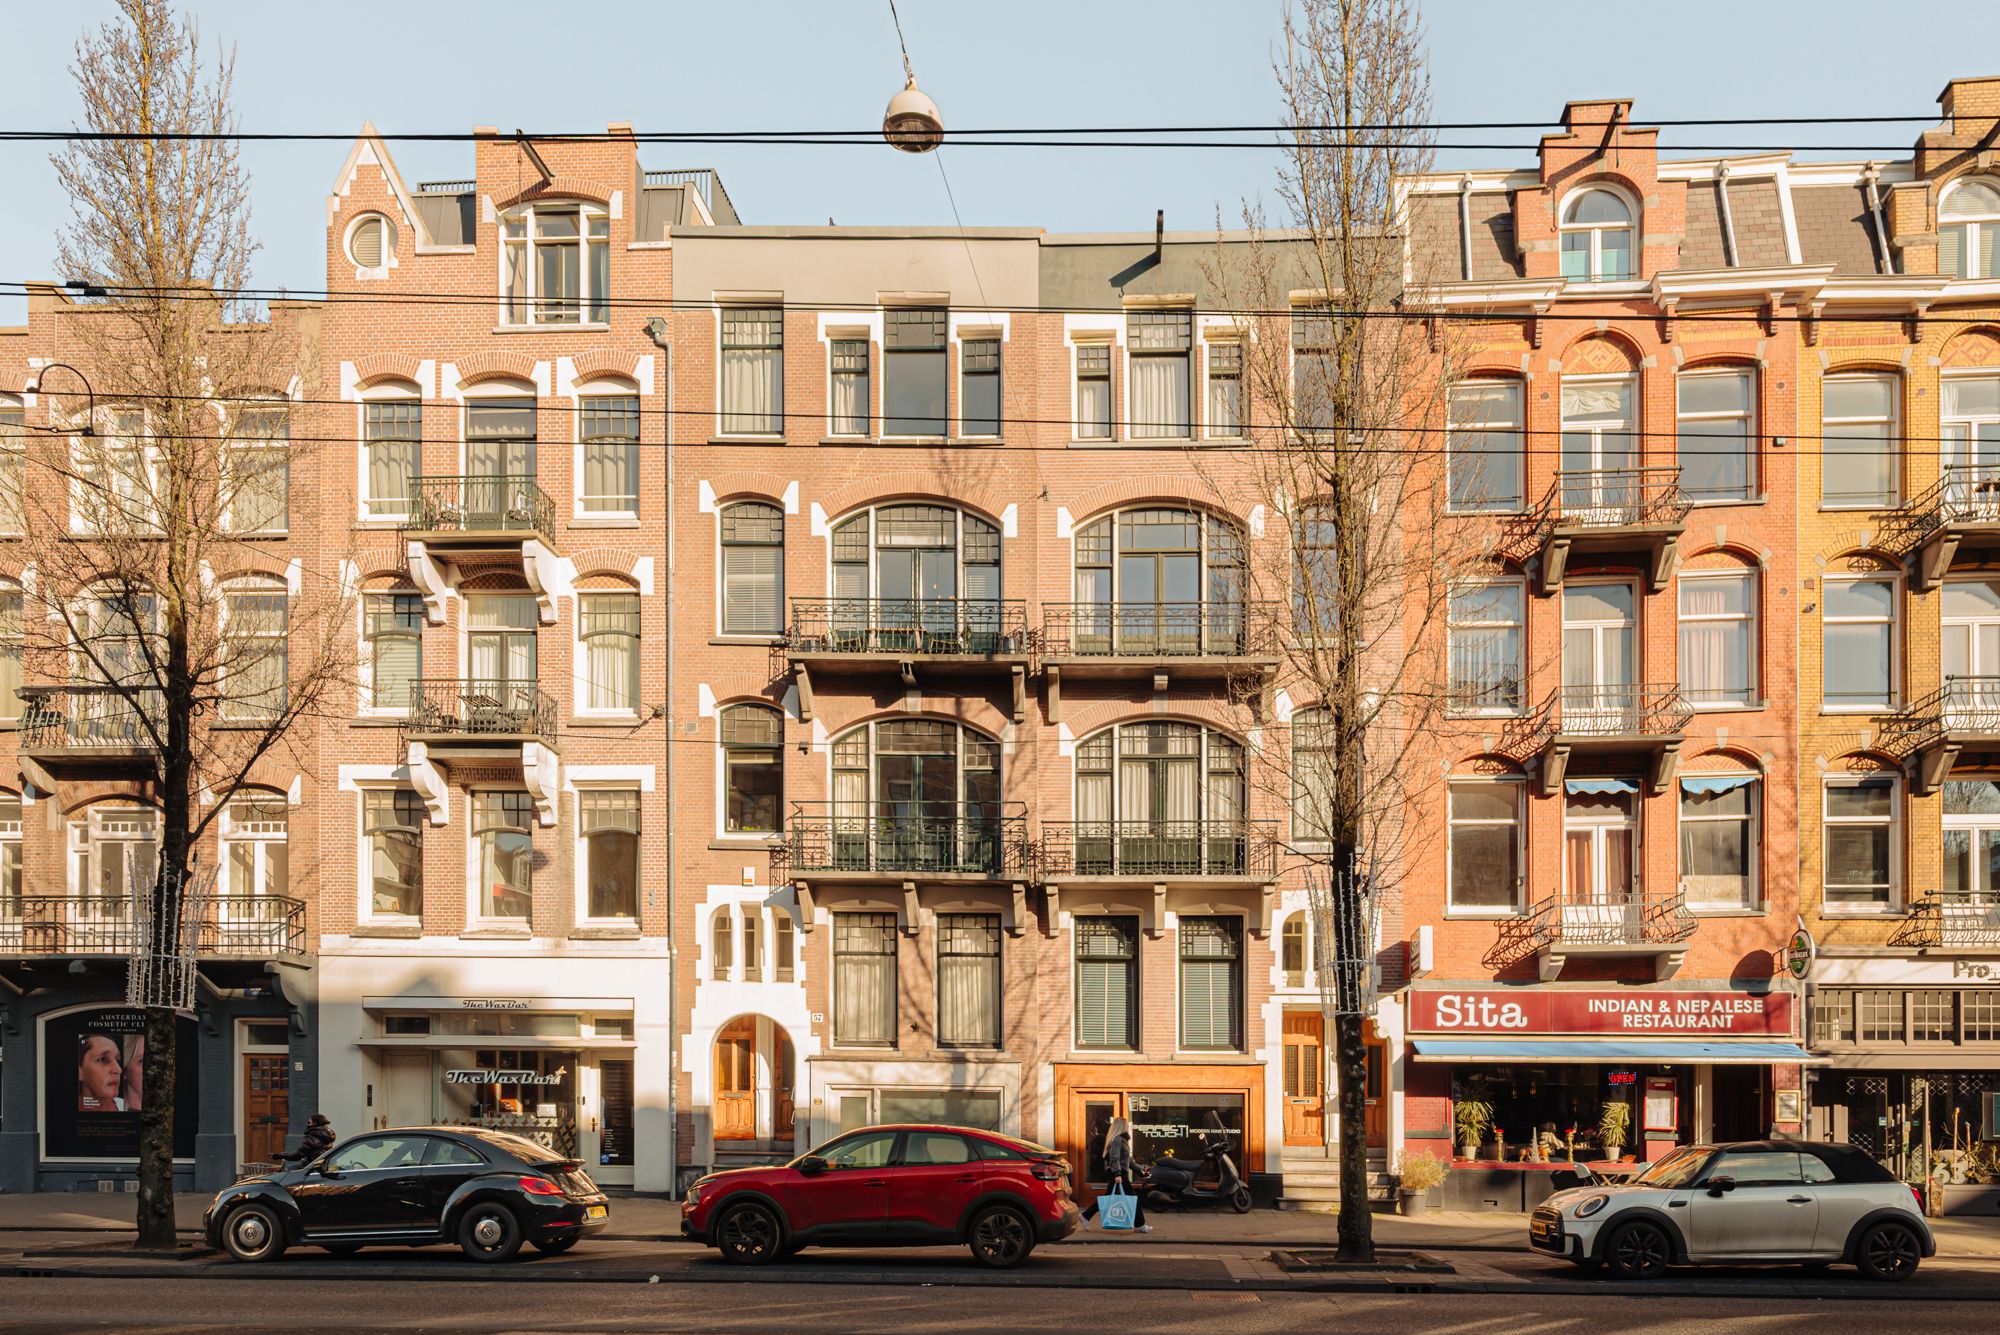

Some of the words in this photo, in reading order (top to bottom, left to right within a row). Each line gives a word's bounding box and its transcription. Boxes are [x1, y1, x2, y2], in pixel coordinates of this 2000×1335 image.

[1953, 960, 1990, 978] Pro
[1436, 994, 1528, 1028] Sita
[1588, 999, 1653, 1012] INDIAN
[1658, 1000, 1671, 1012] &
[1677, 999, 1763, 1013] NEPALESE
[1623, 1014, 1734, 1028] RESTAURANT
[1609, 1073, 1635, 1083] OPEN
[1131, 1124, 1188, 1133] PERFECT
[1143, 1130, 1184, 1138] TOUCH
[1933, 1161, 1966, 1185] 63
